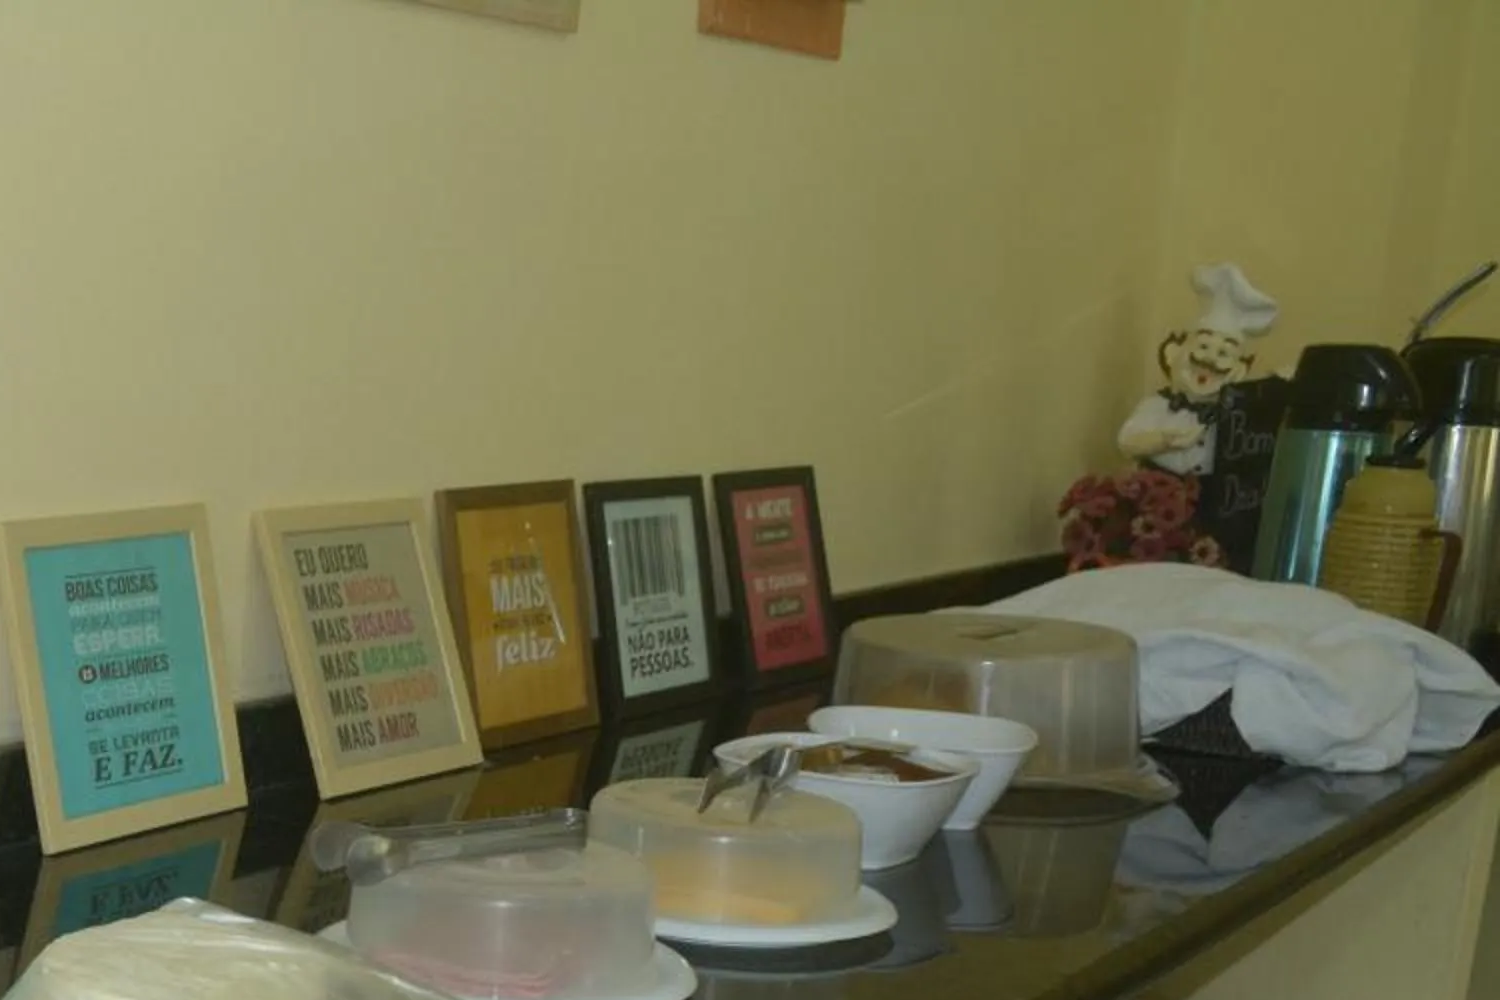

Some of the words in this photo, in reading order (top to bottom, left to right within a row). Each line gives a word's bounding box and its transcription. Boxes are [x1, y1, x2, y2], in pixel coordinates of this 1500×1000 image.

[293, 547, 317, 578] EU
[317, 542, 369, 575] QUERO
[65, 578, 104, 602] BOAS
[106, 571, 158, 598] COISAS
[303, 580, 344, 612] MAIS
[490, 573, 547, 613] MAIS
[312, 615, 351, 647] MAIS
[627, 626, 655, 653] NÃO
[657, 624, 692, 649] PARA
[99, 653, 170, 681] MELHORES
[320, 650, 360, 682] MAIS
[85, 697, 176, 722] acontecem
[328, 685, 369, 719] MAIS
[337, 719, 376, 753] MAIS
[377, 711, 419, 744] AMOR
[95, 756, 113, 782] E
[121, 743, 183, 777] FAZ.
